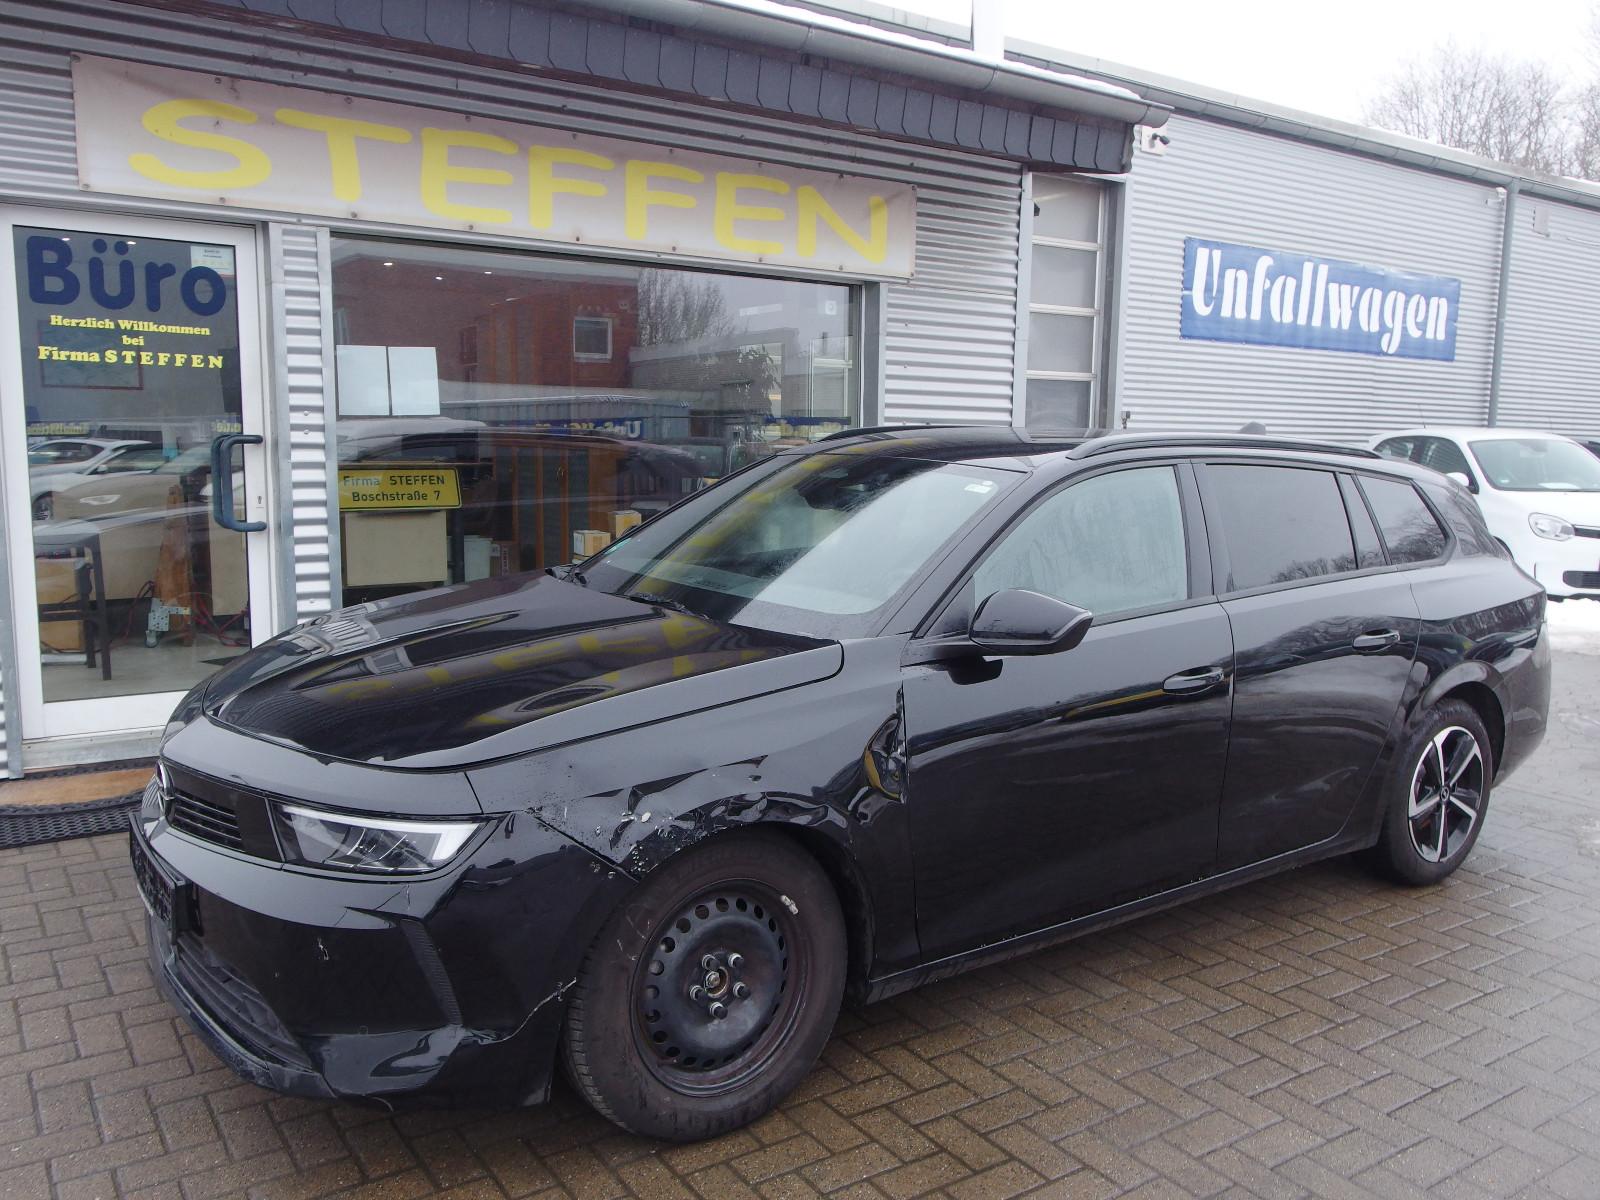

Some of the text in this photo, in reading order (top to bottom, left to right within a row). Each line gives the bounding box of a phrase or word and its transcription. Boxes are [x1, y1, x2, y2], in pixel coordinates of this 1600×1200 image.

[129, 97, 889, 264] STEFFEN
[26, 235, 227, 316] Büro
[1192, 247, 1448, 354] Unfallwagen
[50, 314, 211, 336] Herzlich Willkommen
[122, 334, 145, 346] bei
[37, 345, 100, 363] Firma
[343, 475, 446, 487] Firma STEFFEN
[351, 490, 442, 502] Boschstraße 7
